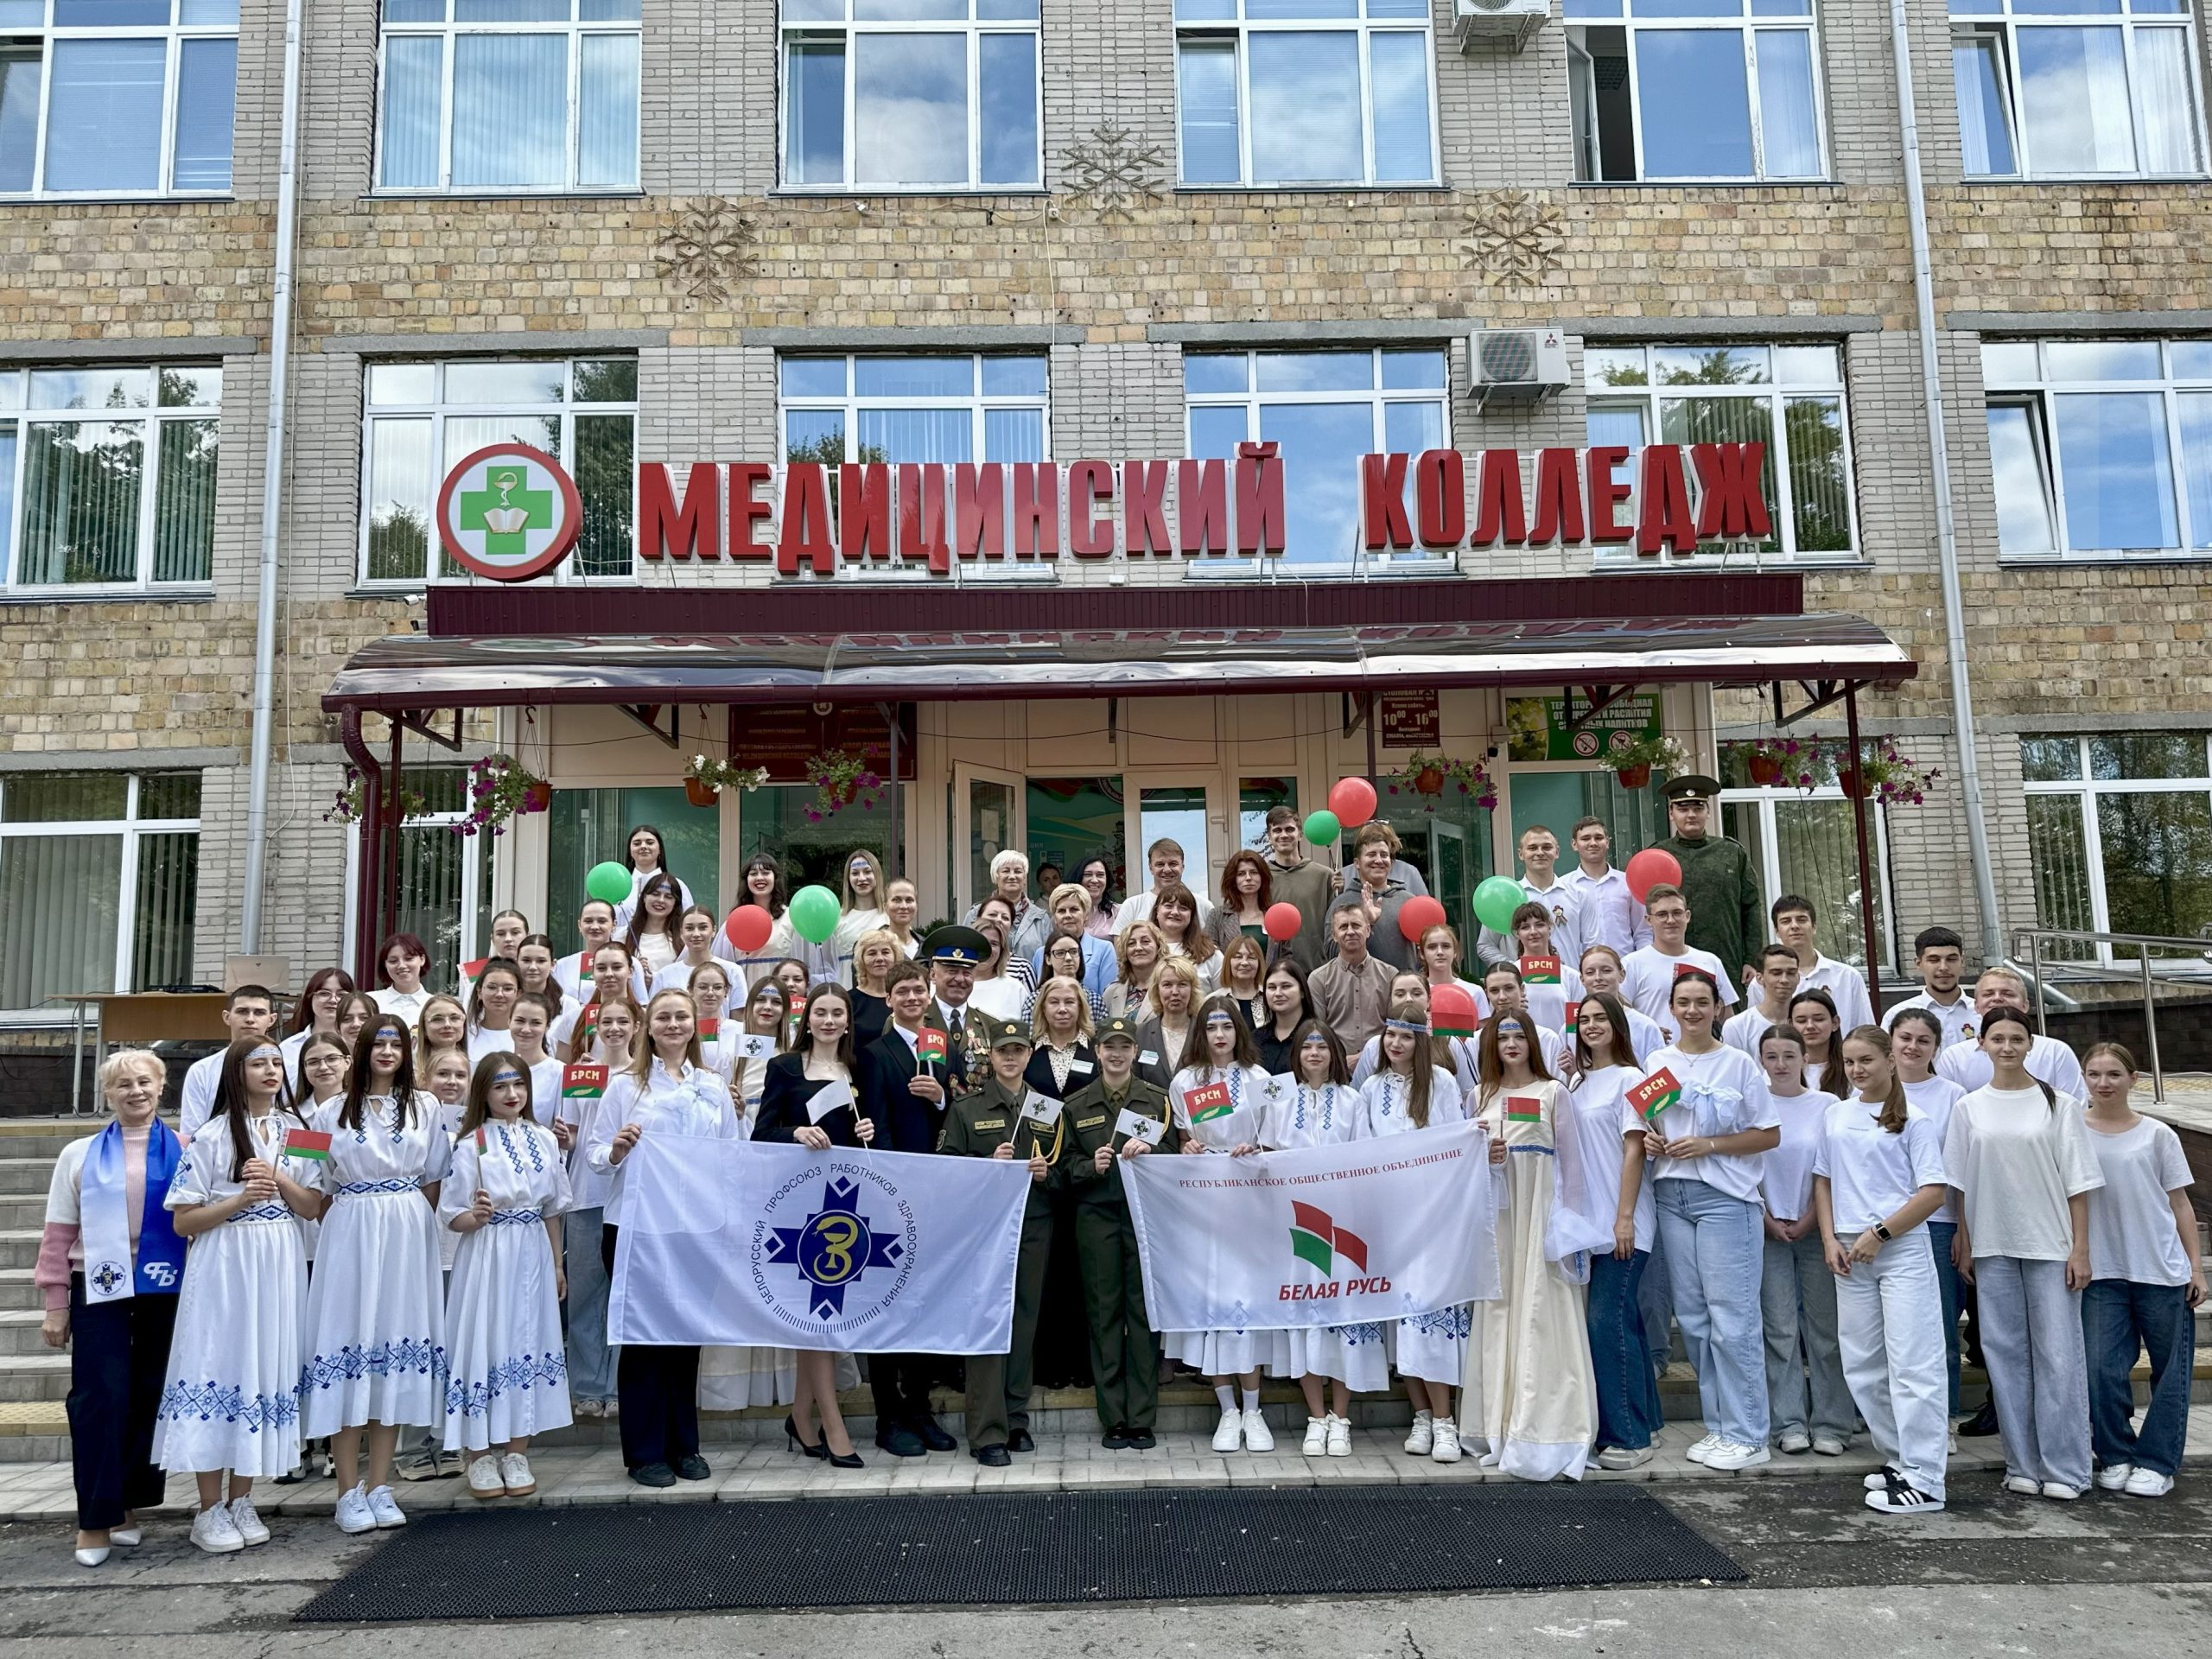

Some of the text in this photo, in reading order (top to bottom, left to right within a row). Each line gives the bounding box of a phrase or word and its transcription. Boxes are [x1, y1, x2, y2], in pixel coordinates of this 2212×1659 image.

[639, 442, 1771, 576] МЕДИЦИНСКИЙ КОЛЛЕДЖ
[1528, 960, 1554, 969] БРСМ
[791, 1001, 806, 1010] БРС
[570, 1070, 601, 1081] БРСМ
[1194, 1089, 1222, 1106] БРСМ
[1639, 1077, 1668, 1101] БРСМ
[1179, 1147, 1464, 1189] РЕСПУБЛИКАНСКОЕ ОБЩЕСТВЕННОЕ ОБЪЕДИНЕНИЕ
[751, 1163, 917, 1307] БЕЛОРУССКИЙ ПРОФСОЮЗ РАБОТНИКОВ ЗДРАВООХРАНЕНИЯ
[1279, 1276, 1393, 1301] БЕЛАЯ РУСЬ
